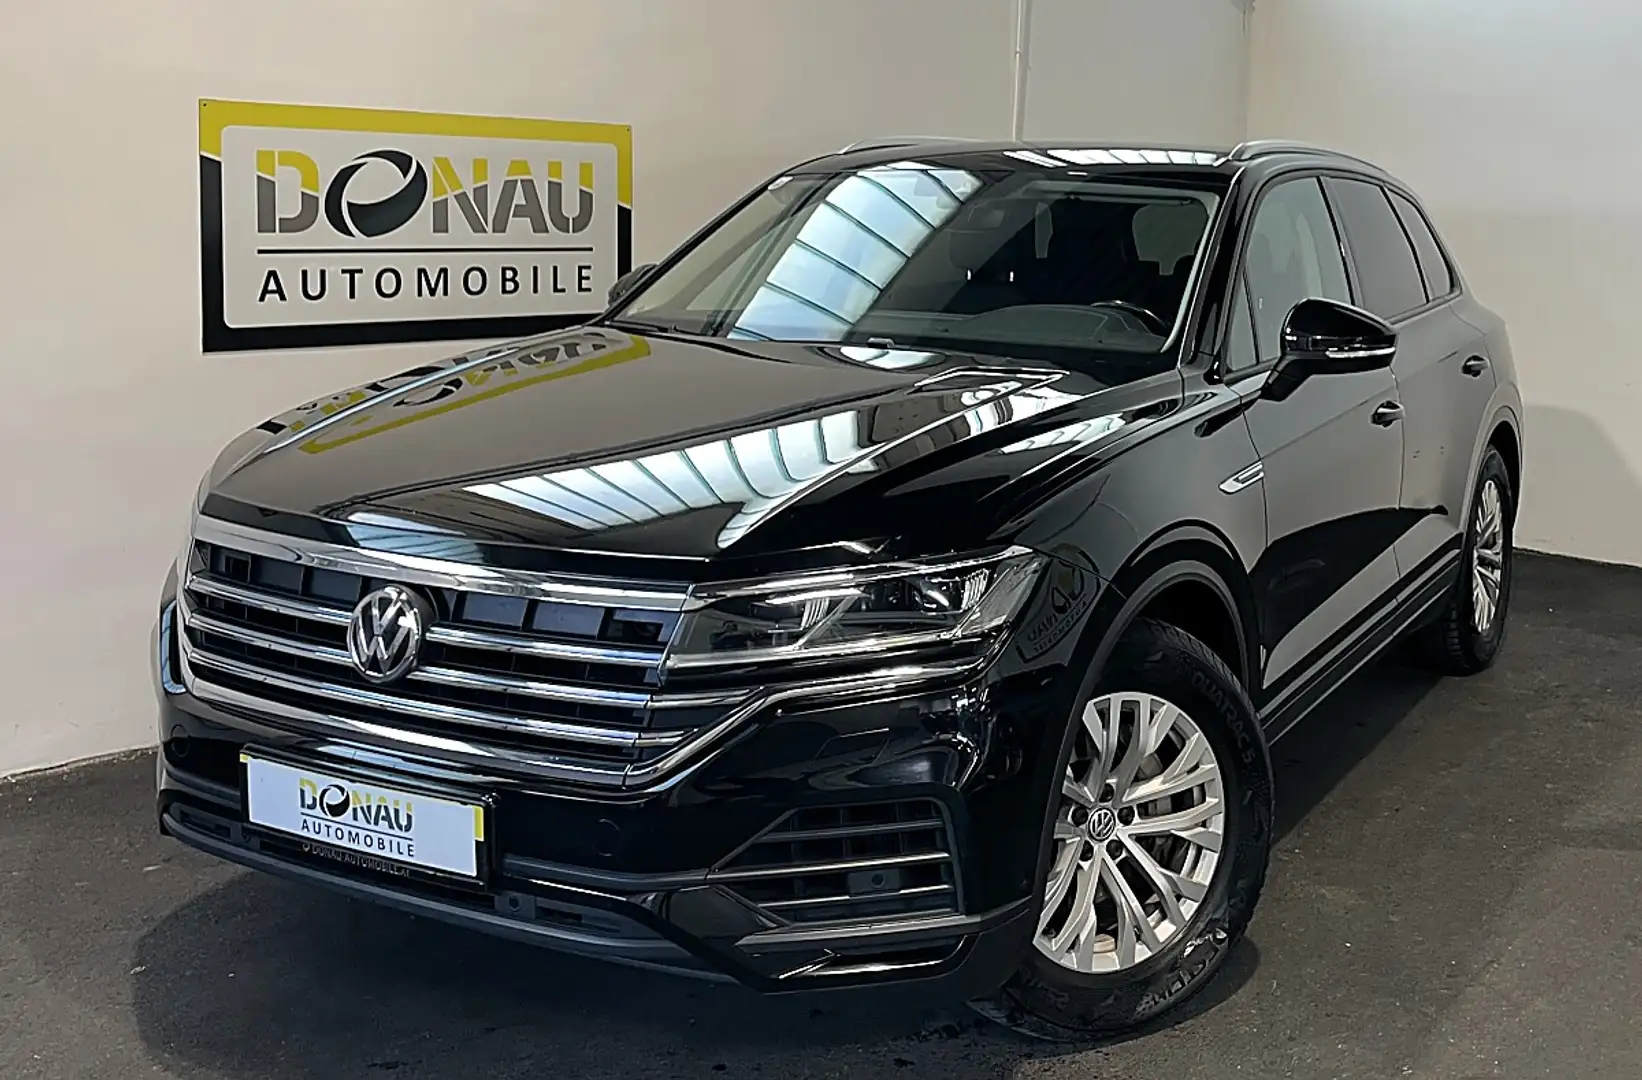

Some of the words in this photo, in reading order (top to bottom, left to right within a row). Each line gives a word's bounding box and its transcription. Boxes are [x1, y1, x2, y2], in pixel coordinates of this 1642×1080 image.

[256, 149, 594, 238] DONAU
[258, 264, 593, 302] AUTOMOBILE
[349, 587, 420, 678] VW
[299, 777, 414, 832] DONAU
[300, 818, 415, 857] AUTOMOBILE
